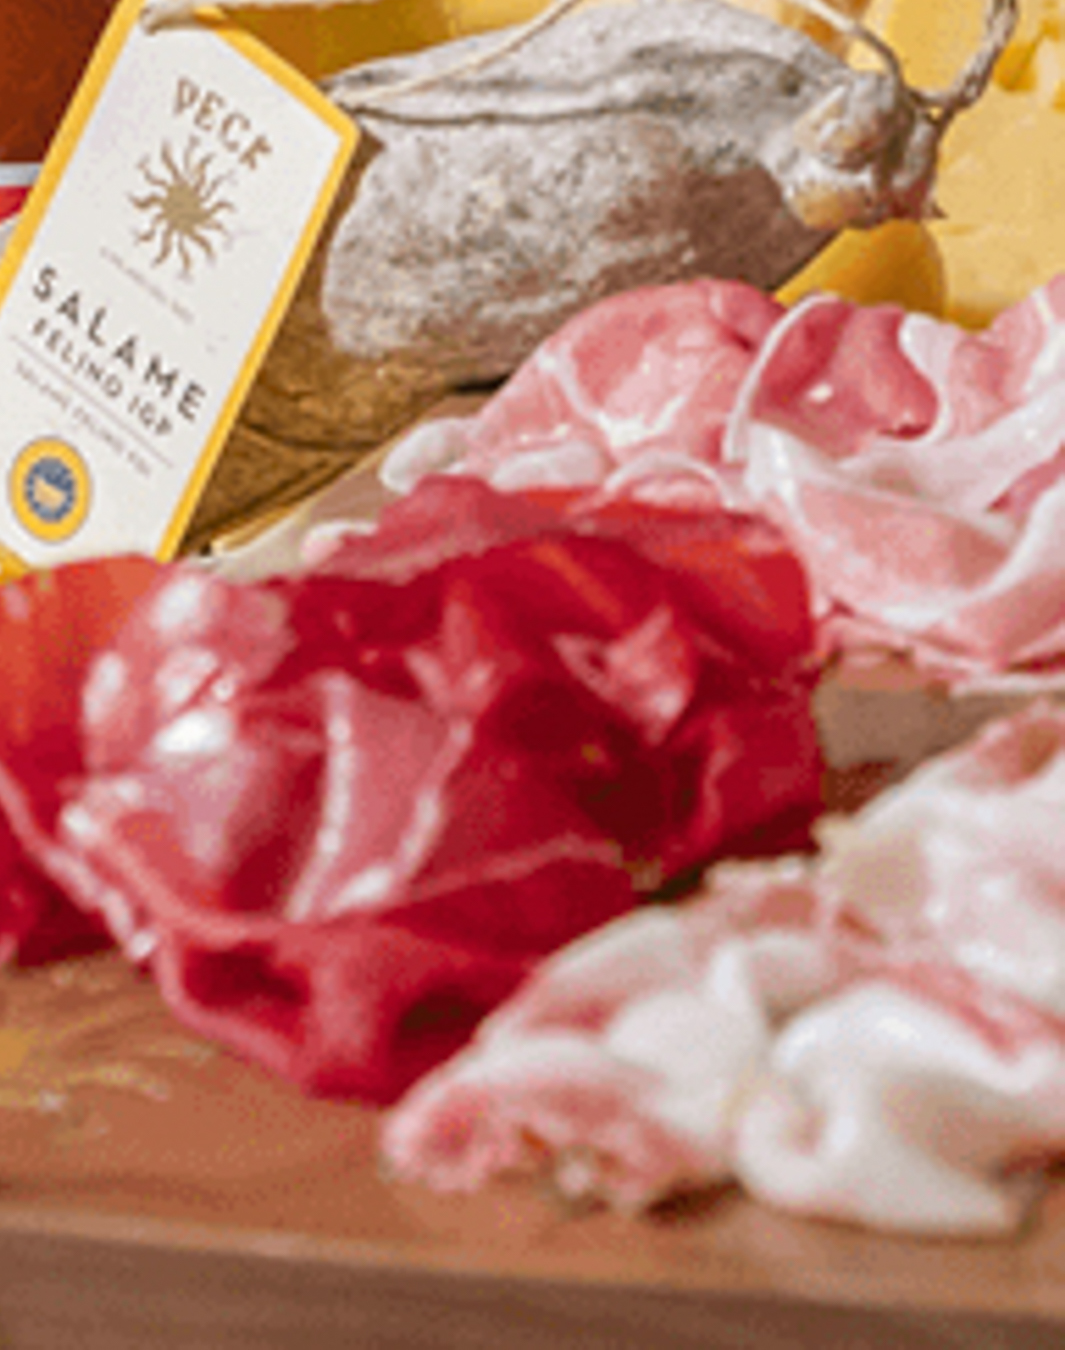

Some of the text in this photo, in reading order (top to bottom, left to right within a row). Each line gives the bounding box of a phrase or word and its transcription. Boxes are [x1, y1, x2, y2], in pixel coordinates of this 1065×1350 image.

[173, 75, 272, 171] PECK
[33, 265, 207, 424] SALAME
[33, 318, 173, 437] FELINO IGP
